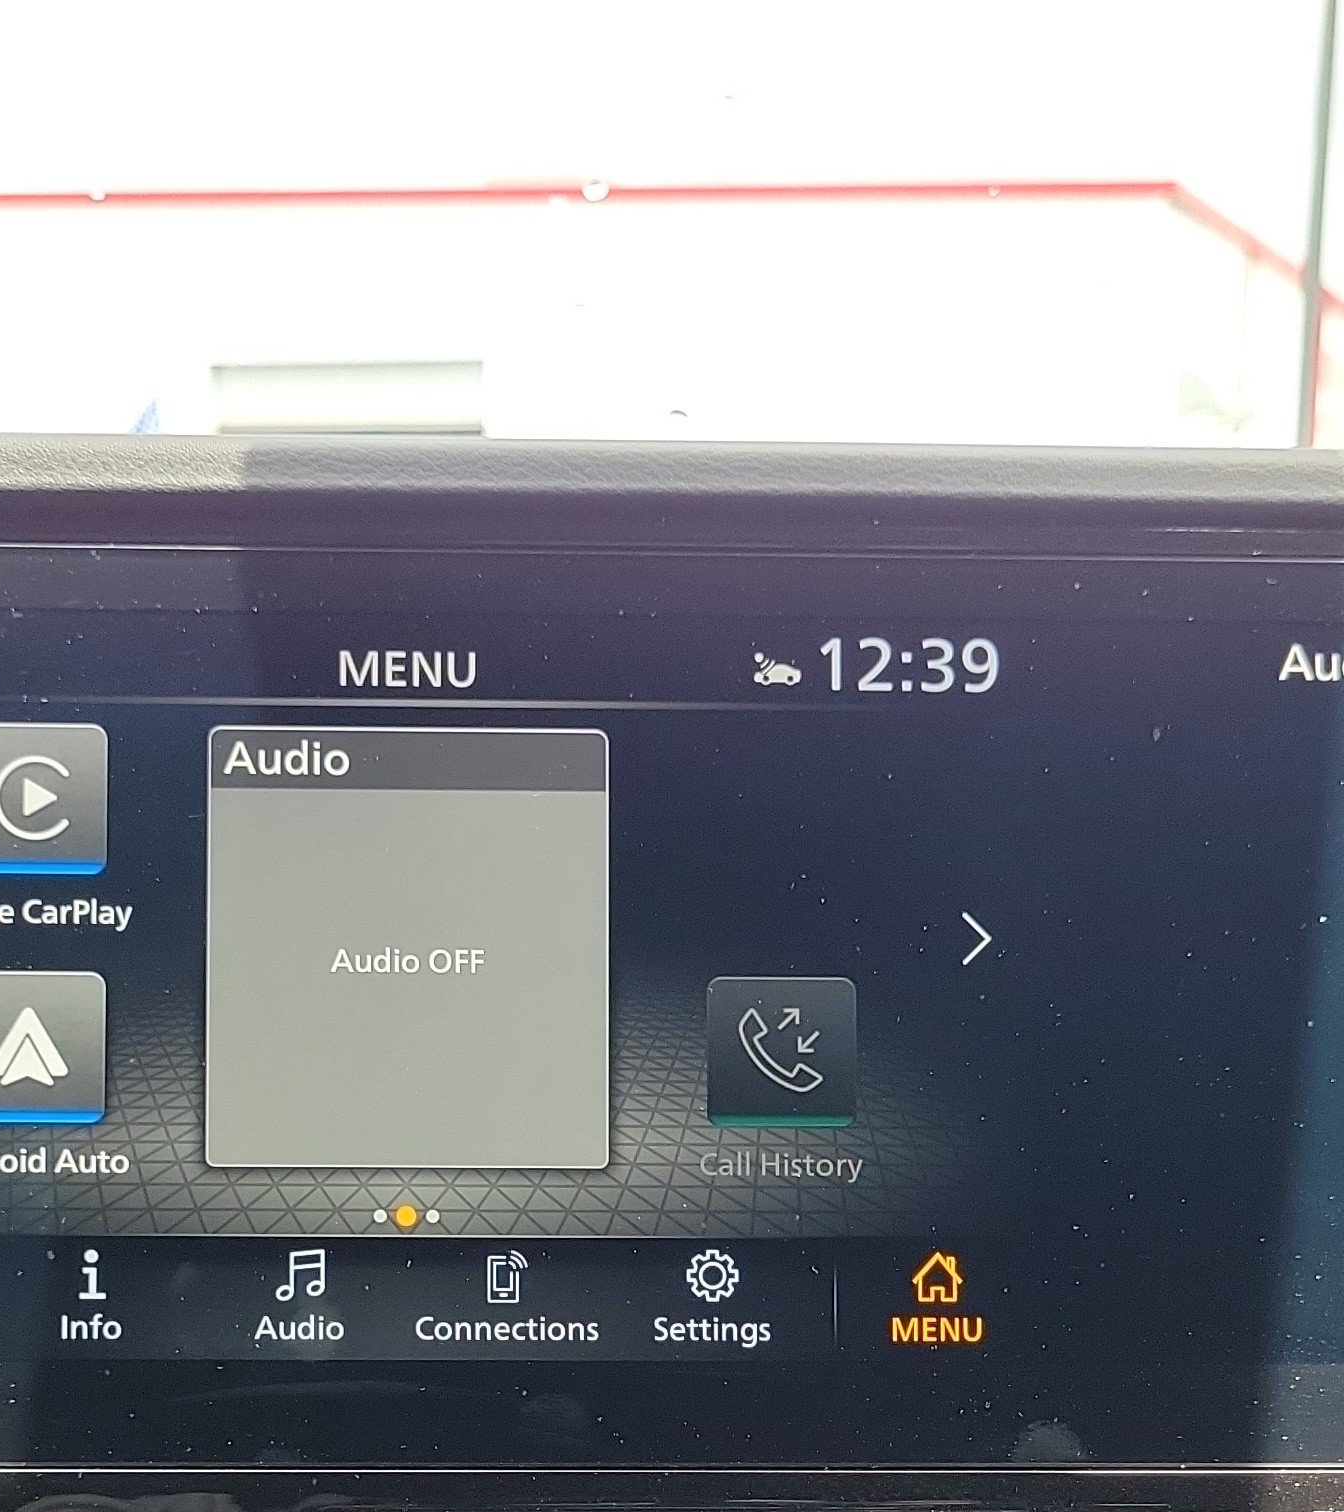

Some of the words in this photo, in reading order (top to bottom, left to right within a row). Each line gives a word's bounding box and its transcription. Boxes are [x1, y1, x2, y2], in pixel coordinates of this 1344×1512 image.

[338, 650, 477, 688] MENU
[819, 636, 999, 694] 12:39
[223, 739, 350, 777] Audio
[21, 898, 133, 931] CarPlay
[330, 948, 420, 974] Audio
[429, 949, 486, 974] OFF
[54, 1148, 130, 1175] Auto
[699, 1150, 753, 1178] Call
[760, 1152, 863, 1185] History
[60, 1313, 122, 1341] Info
[254, 1314, 346, 1342] Audio
[414, 1315, 599, 1343] Connections
[653, 1317, 771, 1349] Settings
[890, 1316, 983, 1344] MENU
